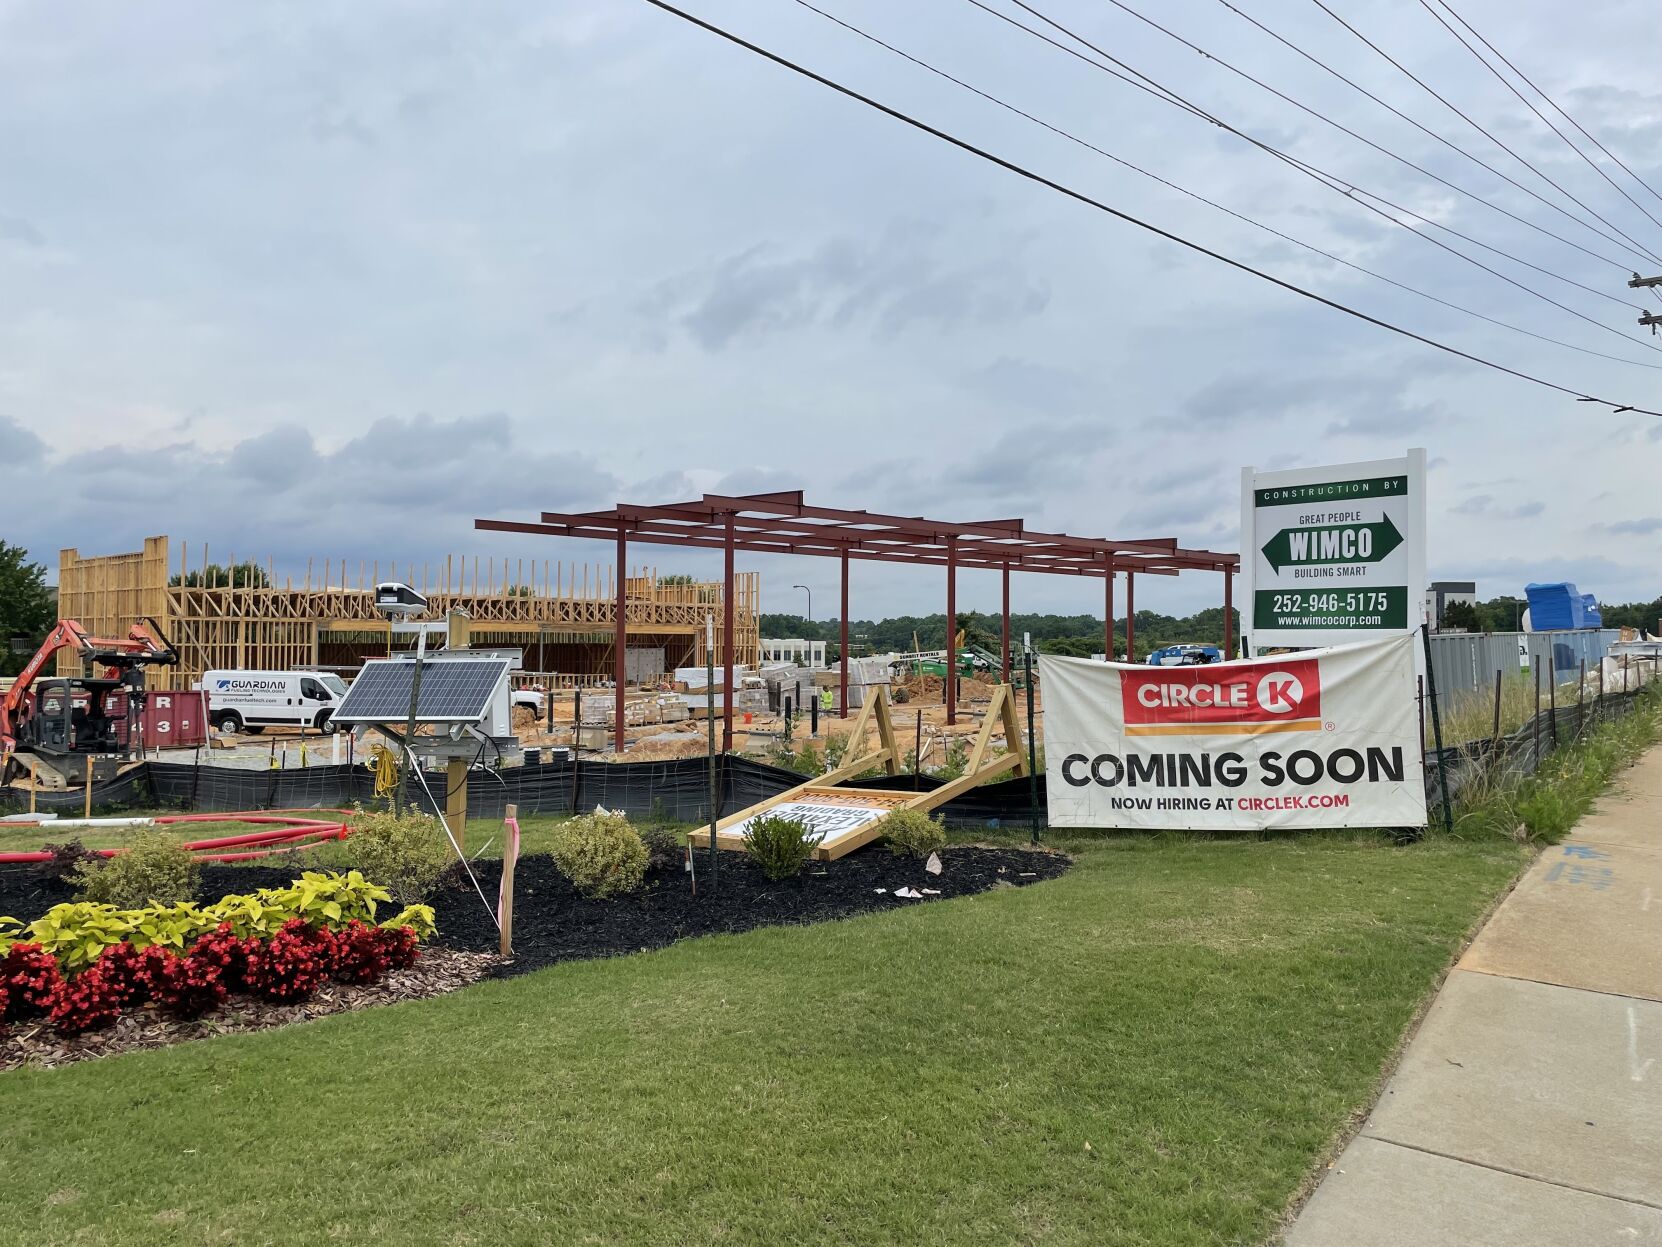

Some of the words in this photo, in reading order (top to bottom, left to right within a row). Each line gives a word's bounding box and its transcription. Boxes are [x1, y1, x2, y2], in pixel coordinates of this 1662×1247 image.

[1264, 483, 1370, 500] CONSTRUCTION
[1384, 480, 1399, 490] BY
[1299, 513, 1326, 525] GREAT
[1328, 511, 1361, 523] PEOPLE
[1288, 527, 1373, 561] WIMCO
[1294, 567, 1334, 579] BUILDING
[1336, 566, 1367, 577] SMART
[1272, 592, 1388, 613] 252-946-5175
[1278, 614, 1381, 628] www.wimcocorp.com
[231, 680, 286, 689] GUARDIAN
[1137, 682, 1249, 708] CIRCLE
[1264, 675, 1303, 713] K
[1061, 752, 1248, 788] COMING
[1259, 746, 1404, 786] SOON
[790, 805, 870, 817] GRADING
[1111, 797, 1153, 810] NOW
[1157, 797, 1212, 810] HIRING
[1215, 797, 1234, 810] AT
[1237, 794, 1350, 811] CIRCLEK.COM
